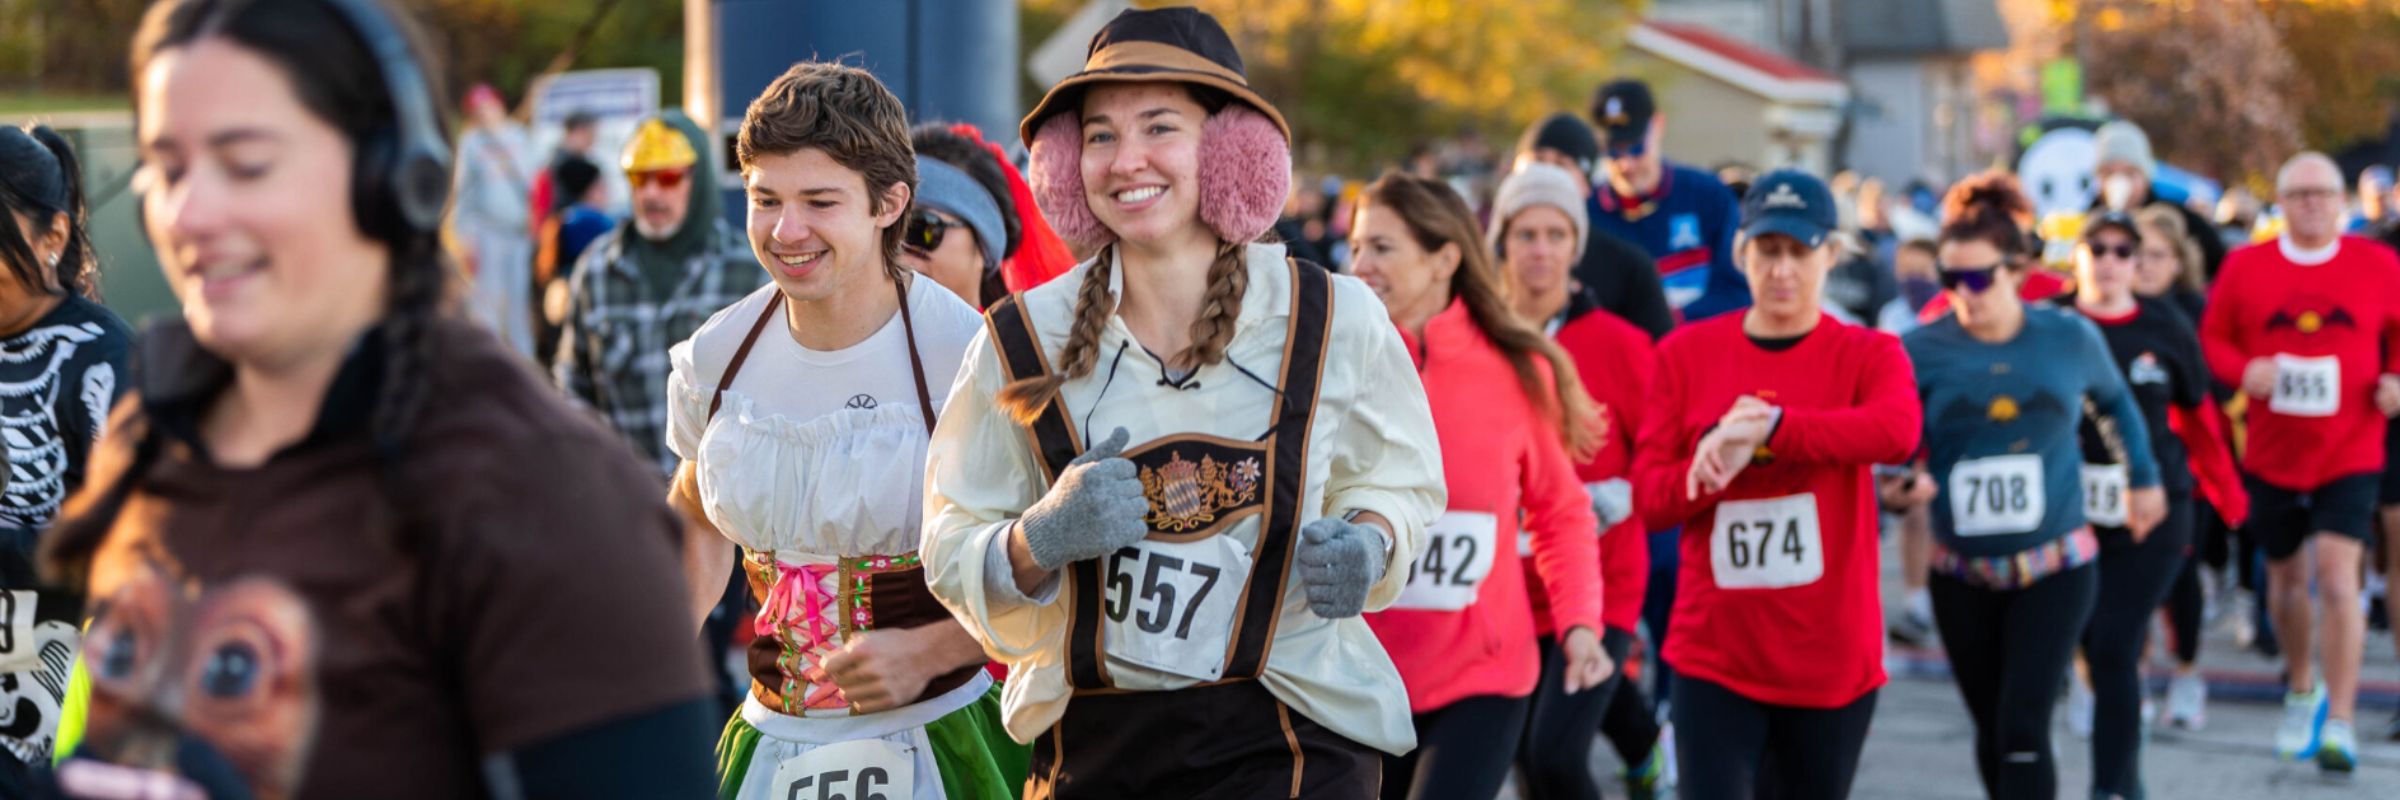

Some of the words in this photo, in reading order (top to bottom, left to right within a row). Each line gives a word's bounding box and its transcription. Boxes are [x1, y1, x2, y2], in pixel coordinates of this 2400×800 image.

[1966, 475, 2028, 514] 708
[1406, 534, 1478, 586] 42
[1728, 518, 1806, 569] 674
[1105, 546, 1221, 640] 557
